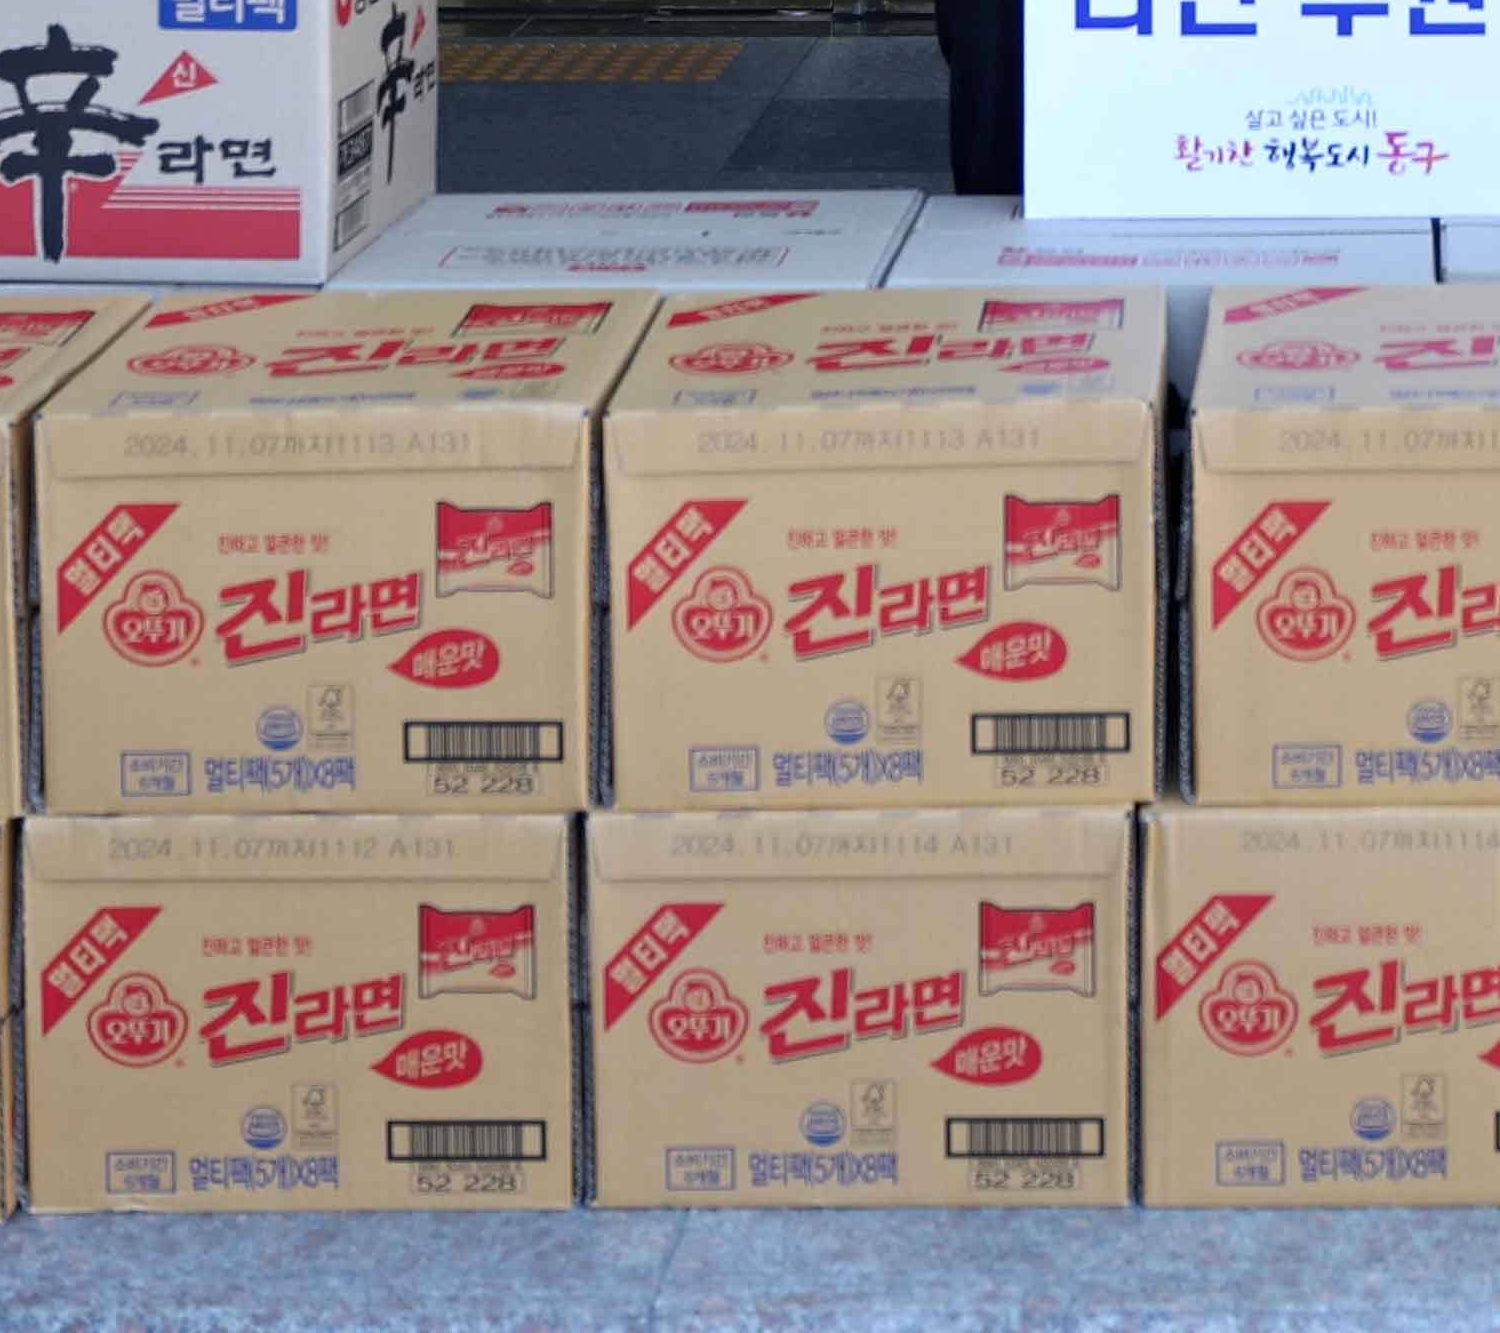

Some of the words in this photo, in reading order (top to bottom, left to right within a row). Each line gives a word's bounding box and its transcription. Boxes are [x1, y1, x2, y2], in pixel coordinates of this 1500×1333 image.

[1246, 109, 1282, 130] 살고
[1290, 109, 1325, 130] 싶은
[1333, 110, 1376, 129] 도시!
[158, 135, 278, 184] 라면
[1175, 135, 1253, 171] 활기찬
[1264, 137, 1369, 173] 행복도시
[1377, 131, 1449, 174] 동구
